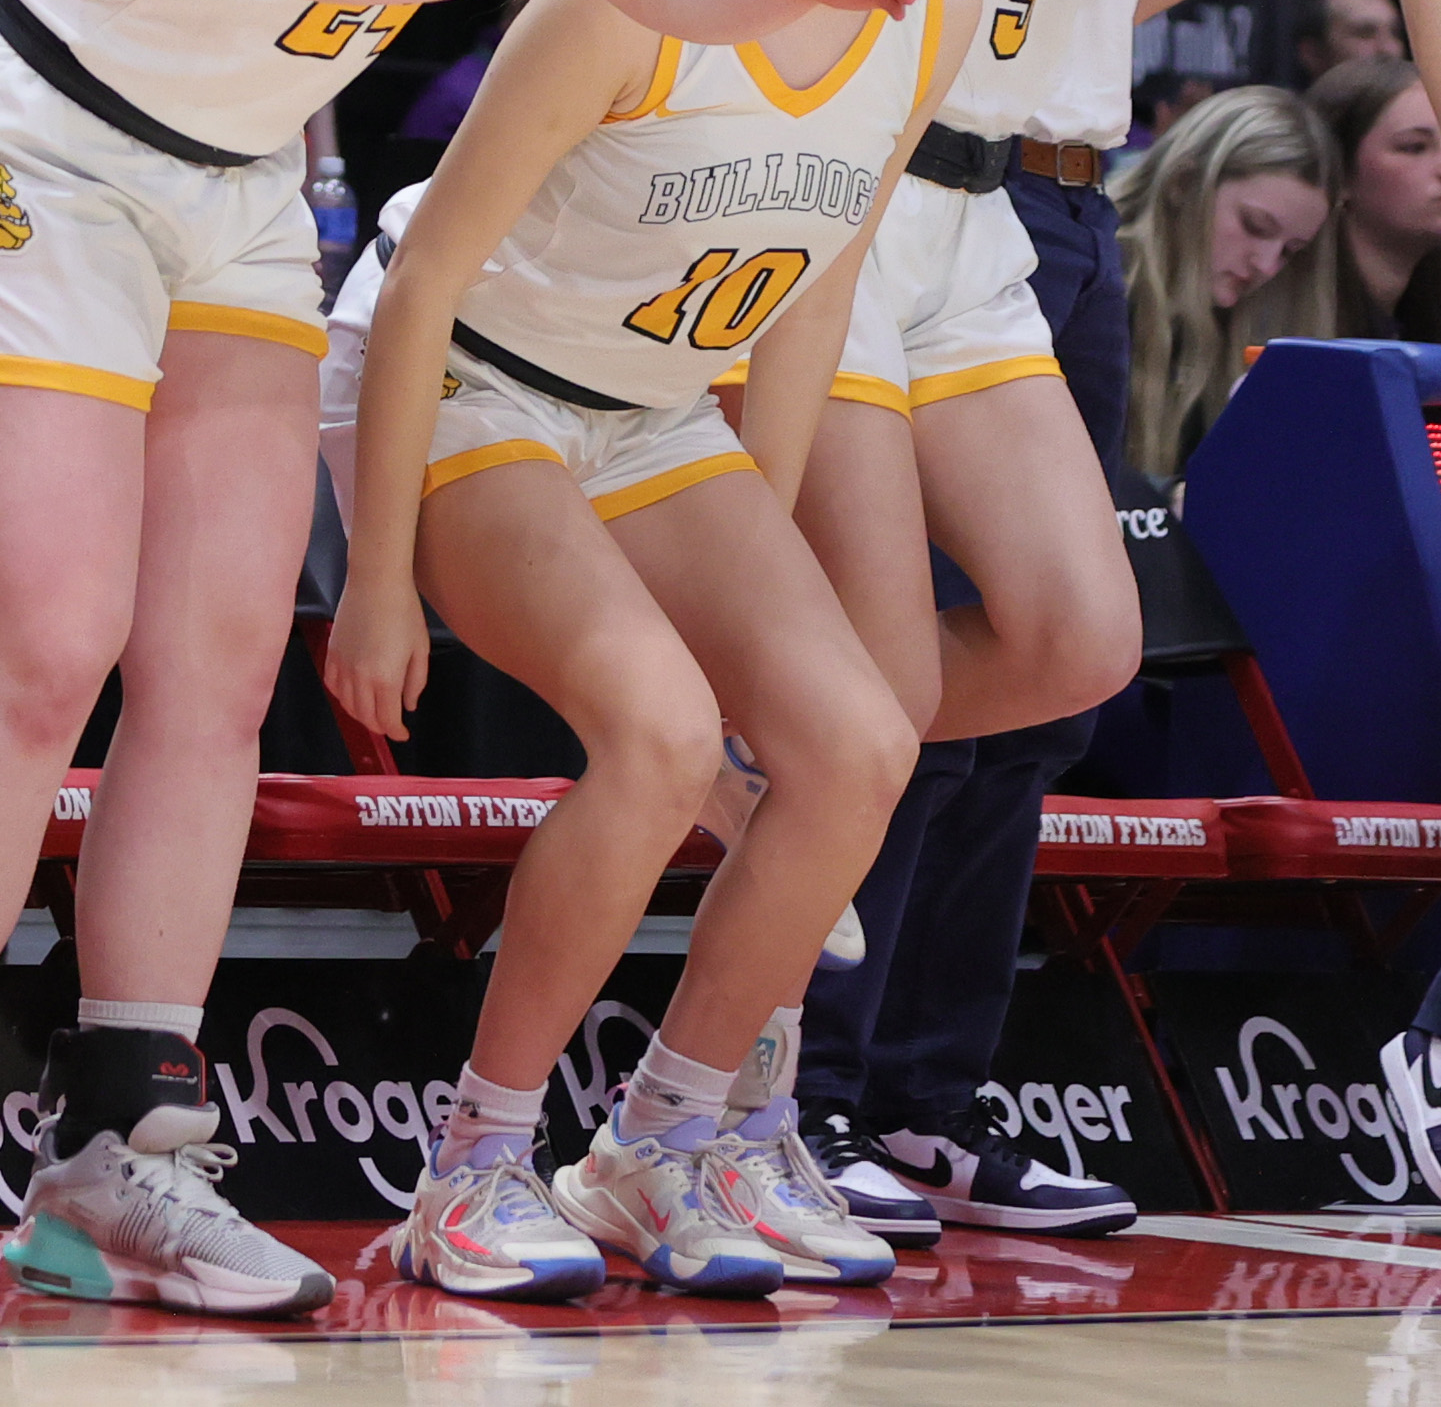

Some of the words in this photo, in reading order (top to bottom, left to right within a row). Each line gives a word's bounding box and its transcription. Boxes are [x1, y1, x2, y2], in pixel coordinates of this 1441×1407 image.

[622, 248, 811, 350] 10
[355, 795, 461, 827] DAYTON
[462, 796, 558, 827] FLYER
[1115, 815, 1207, 847] FLYERS
[1333, 816, 1420, 848] DAYTON
[1215, 1015, 1409, 1202] Krog
